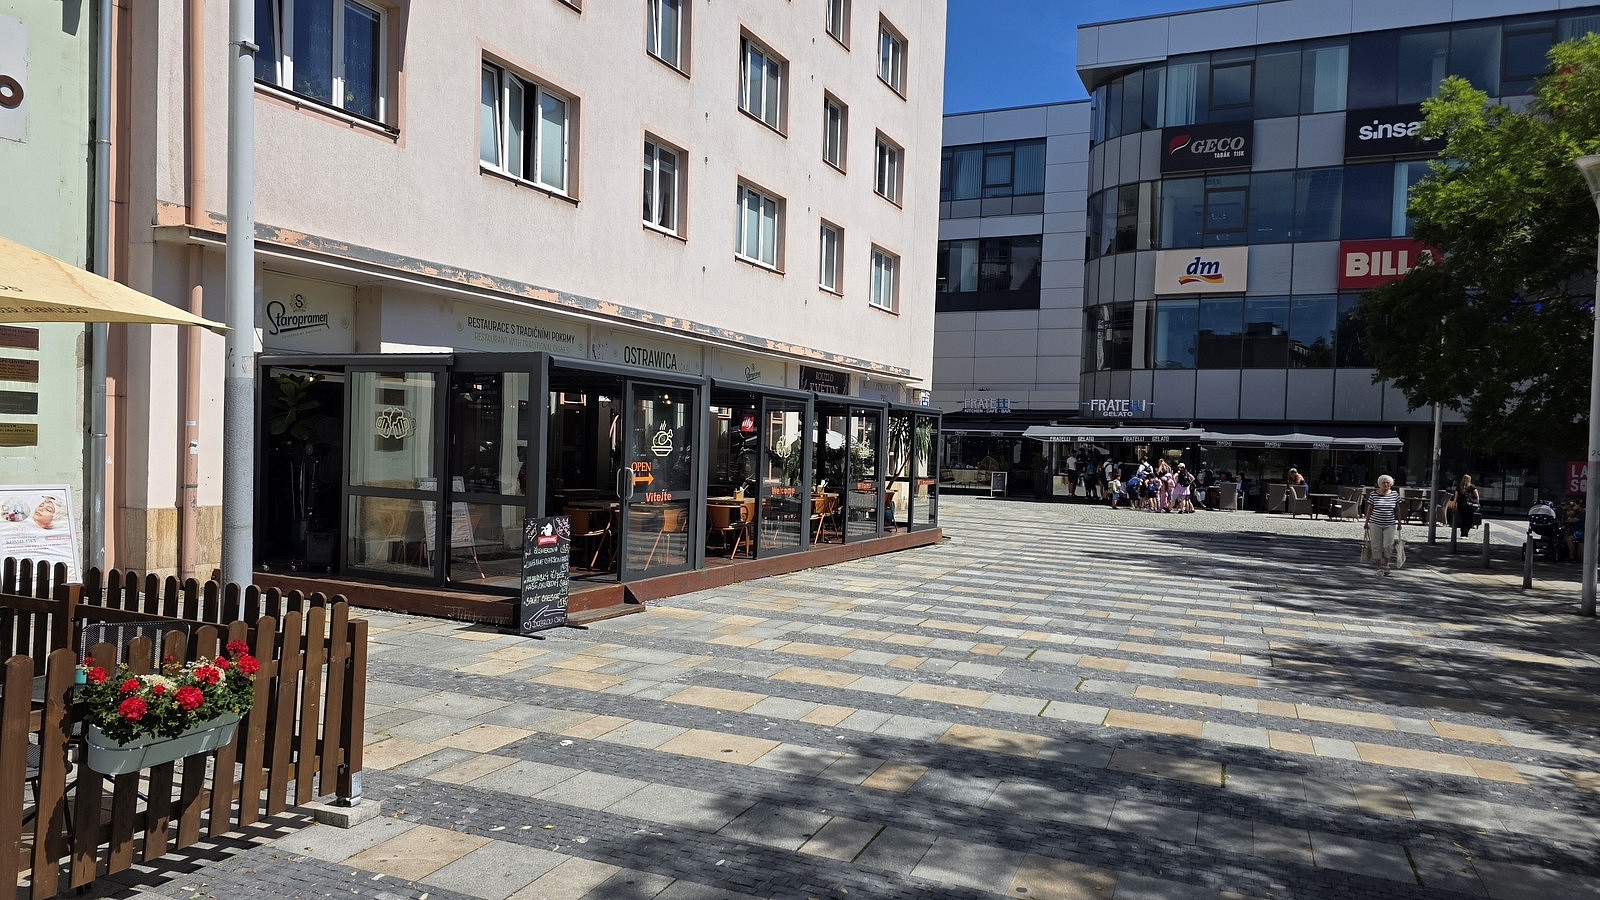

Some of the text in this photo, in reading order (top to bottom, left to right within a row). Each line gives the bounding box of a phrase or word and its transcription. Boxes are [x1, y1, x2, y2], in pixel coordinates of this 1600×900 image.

[1359, 120, 1433, 141] sinsa
[1190, 136, 1245, 154] GECO
[1214, 150, 1231, 159] TABÁK
[1186, 256, 1220, 275] dm
[266, 300, 330, 335] Staropramen
[467, 316, 576, 344] RESTAURACE S TRADIČNÍMI POKRMY
[624, 345, 677, 370] OSTRAWICA
[741, 416, 754, 430] illy
[631, 461, 652, 472] OPEN
